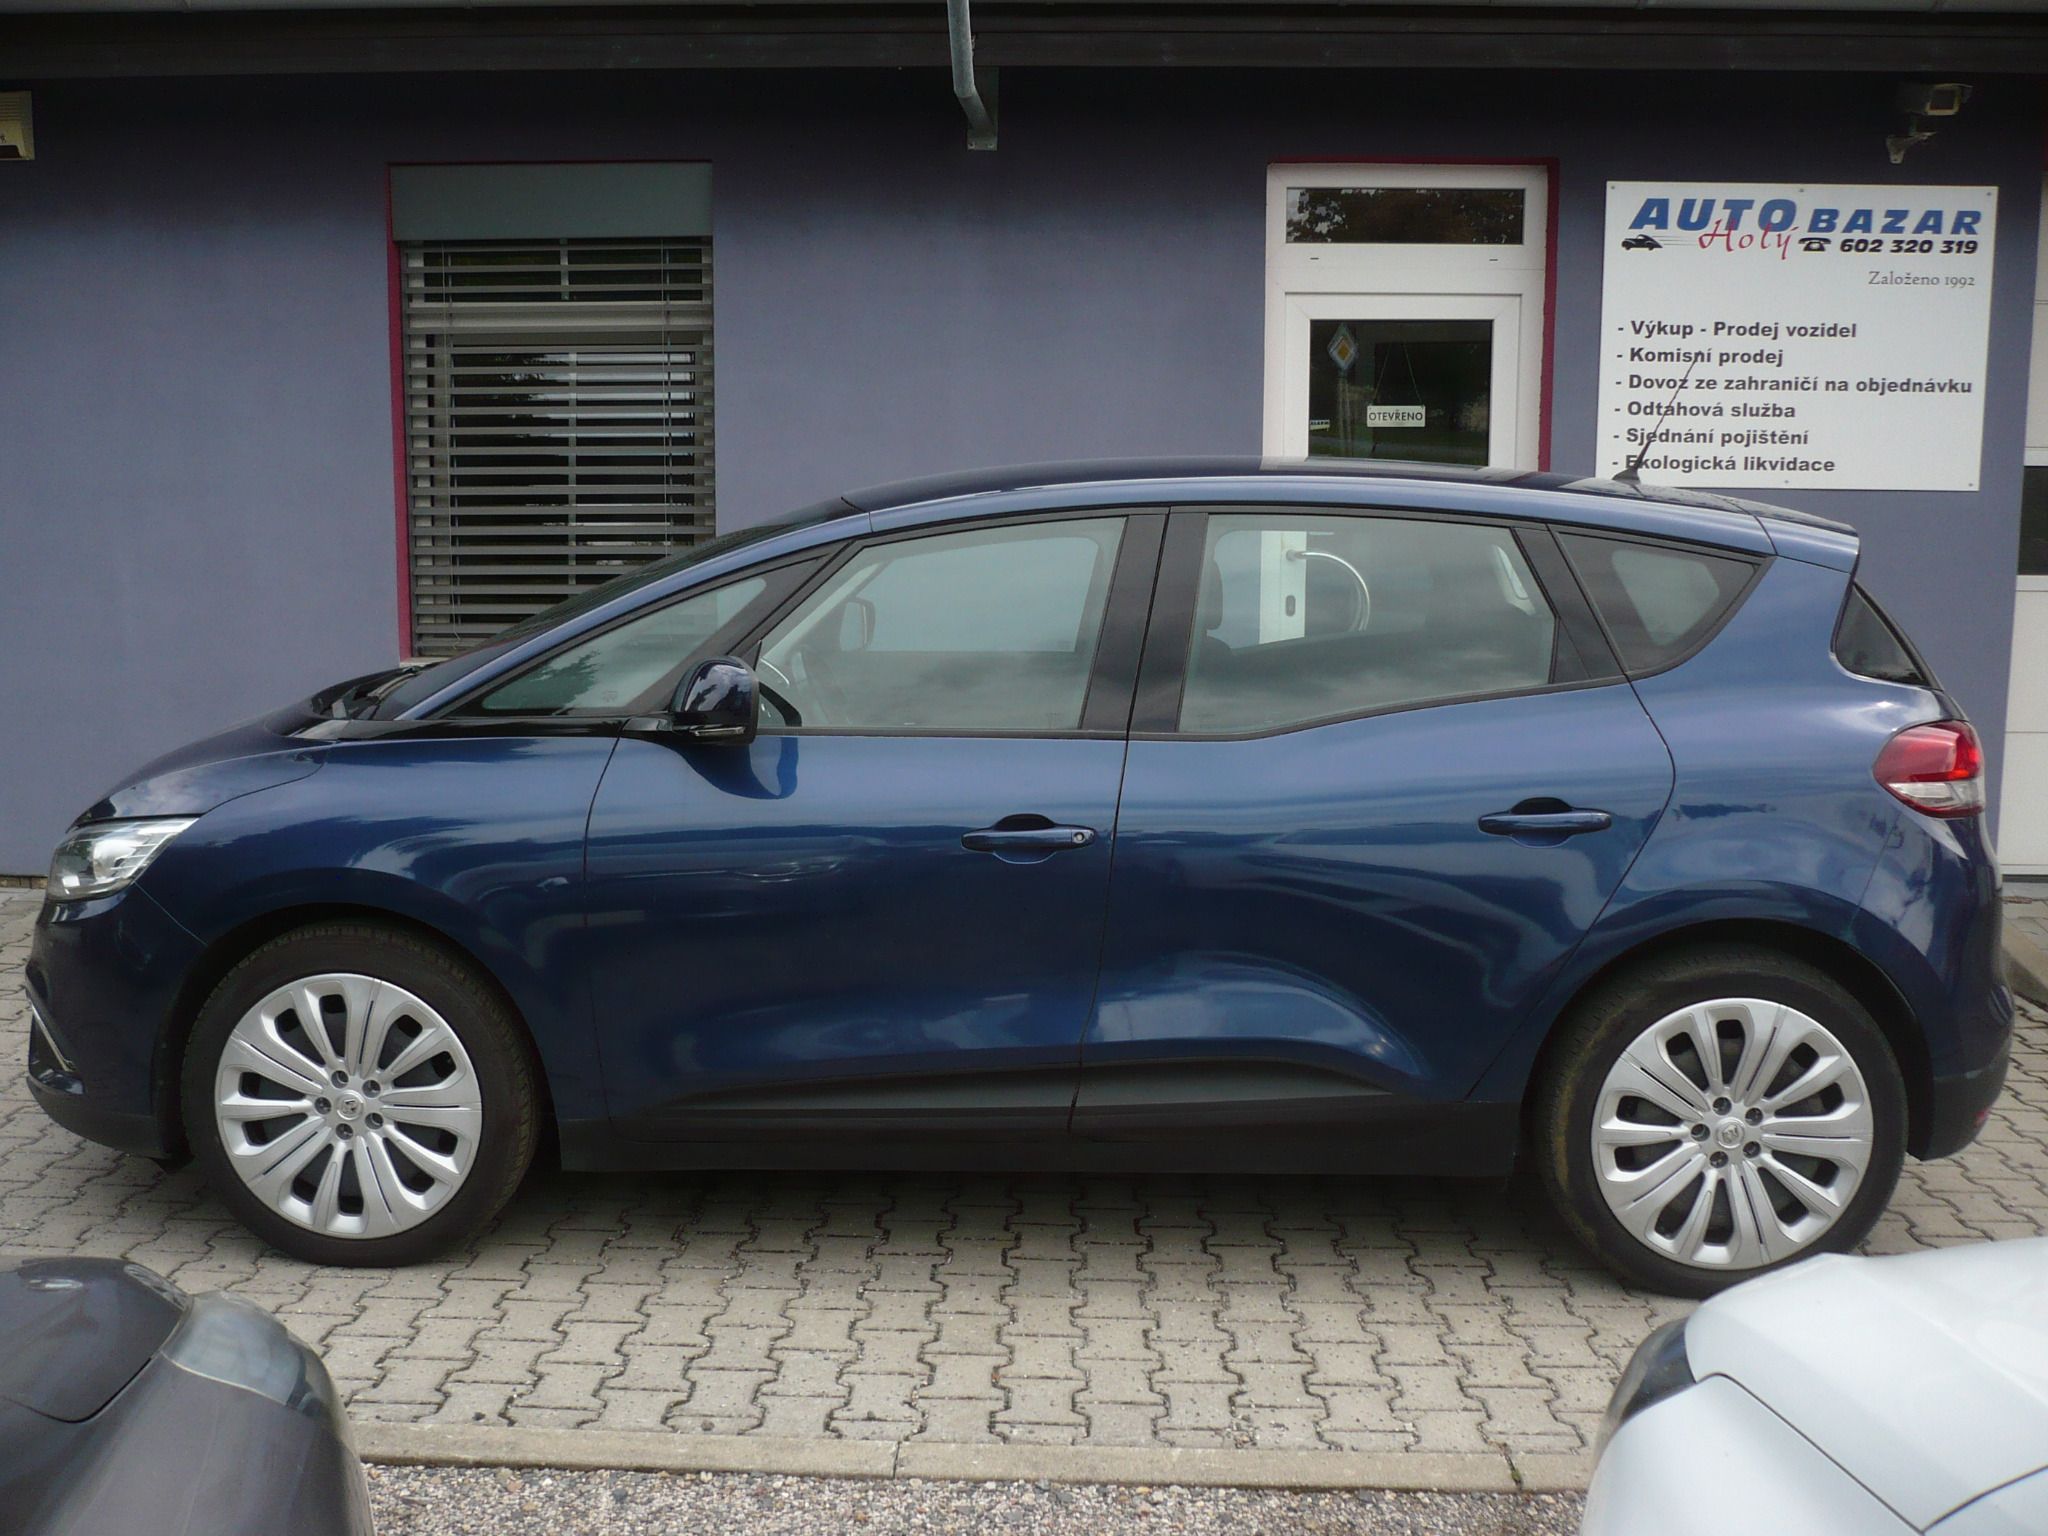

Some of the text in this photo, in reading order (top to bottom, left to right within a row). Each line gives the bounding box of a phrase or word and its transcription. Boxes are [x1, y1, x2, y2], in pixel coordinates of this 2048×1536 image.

[1628, 198, 1982, 235] AUTO BAZAR
[1698, 218, 1800, 260] Holý
[1839, 238, 1978, 255] 602 320 319
[1868, 271, 1975, 288] Založeno 1992
[1631, 319, 1694, 339] Výkup
[1713, 321, 1779, 341] Prodej
[1786, 323, 1856, 338] vozidel
[1630, 347, 1712, 363] Komisní
[1718, 349, 1783, 367] prodej
[1628, 375, 1688, 390] Dovoz
[1695, 377, 1717, 390] ze
[1724, 375, 1818, 391] zahraničí
[1825, 379, 1849, 392] na
[1855, 377, 1972, 396] objednávku
[1369, 409, 1423, 420] OTEVŘENO
[1627, 401, 1724, 417] Odtahová
[1730, 402, 1796, 418] služba
[1626, 428, 1714, 446] Sjednání
[1721, 430, 1809, 448] pojištění
[1625, 455, 1736, 473] Ekologická
[1744, 457, 1835, 472] likvidace
